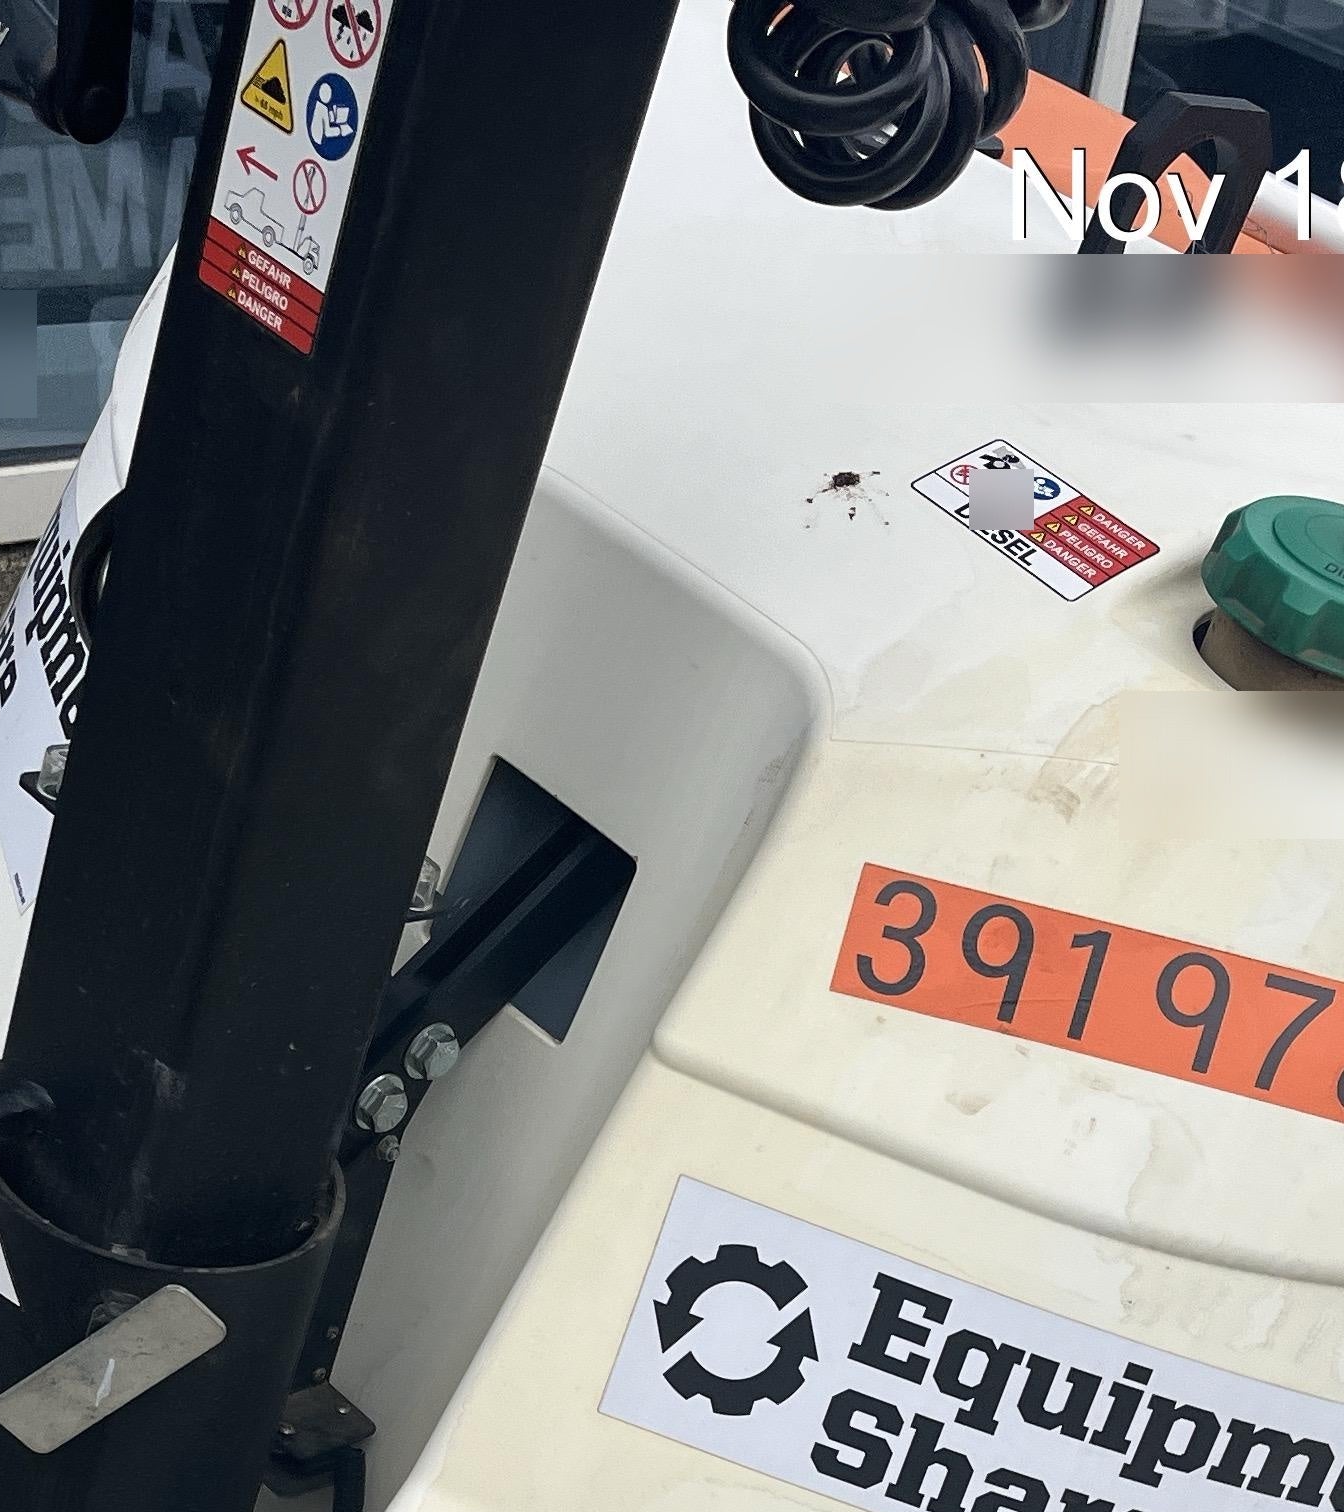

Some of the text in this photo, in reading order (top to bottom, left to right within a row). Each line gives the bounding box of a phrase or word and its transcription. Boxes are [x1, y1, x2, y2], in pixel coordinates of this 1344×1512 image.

[247, 250, 291, 290] GEFAHR
[241, 271, 288, 311] PELIGRO
[237, 291, 283, 332] DANGER
[1059, 530, 1113, 569] PELIGRO
[1077, 523, 1128, 560] GEFAHR
[1093, 512, 1146, 550] DANGER
[1044, 540, 1097, 579] DANGER
